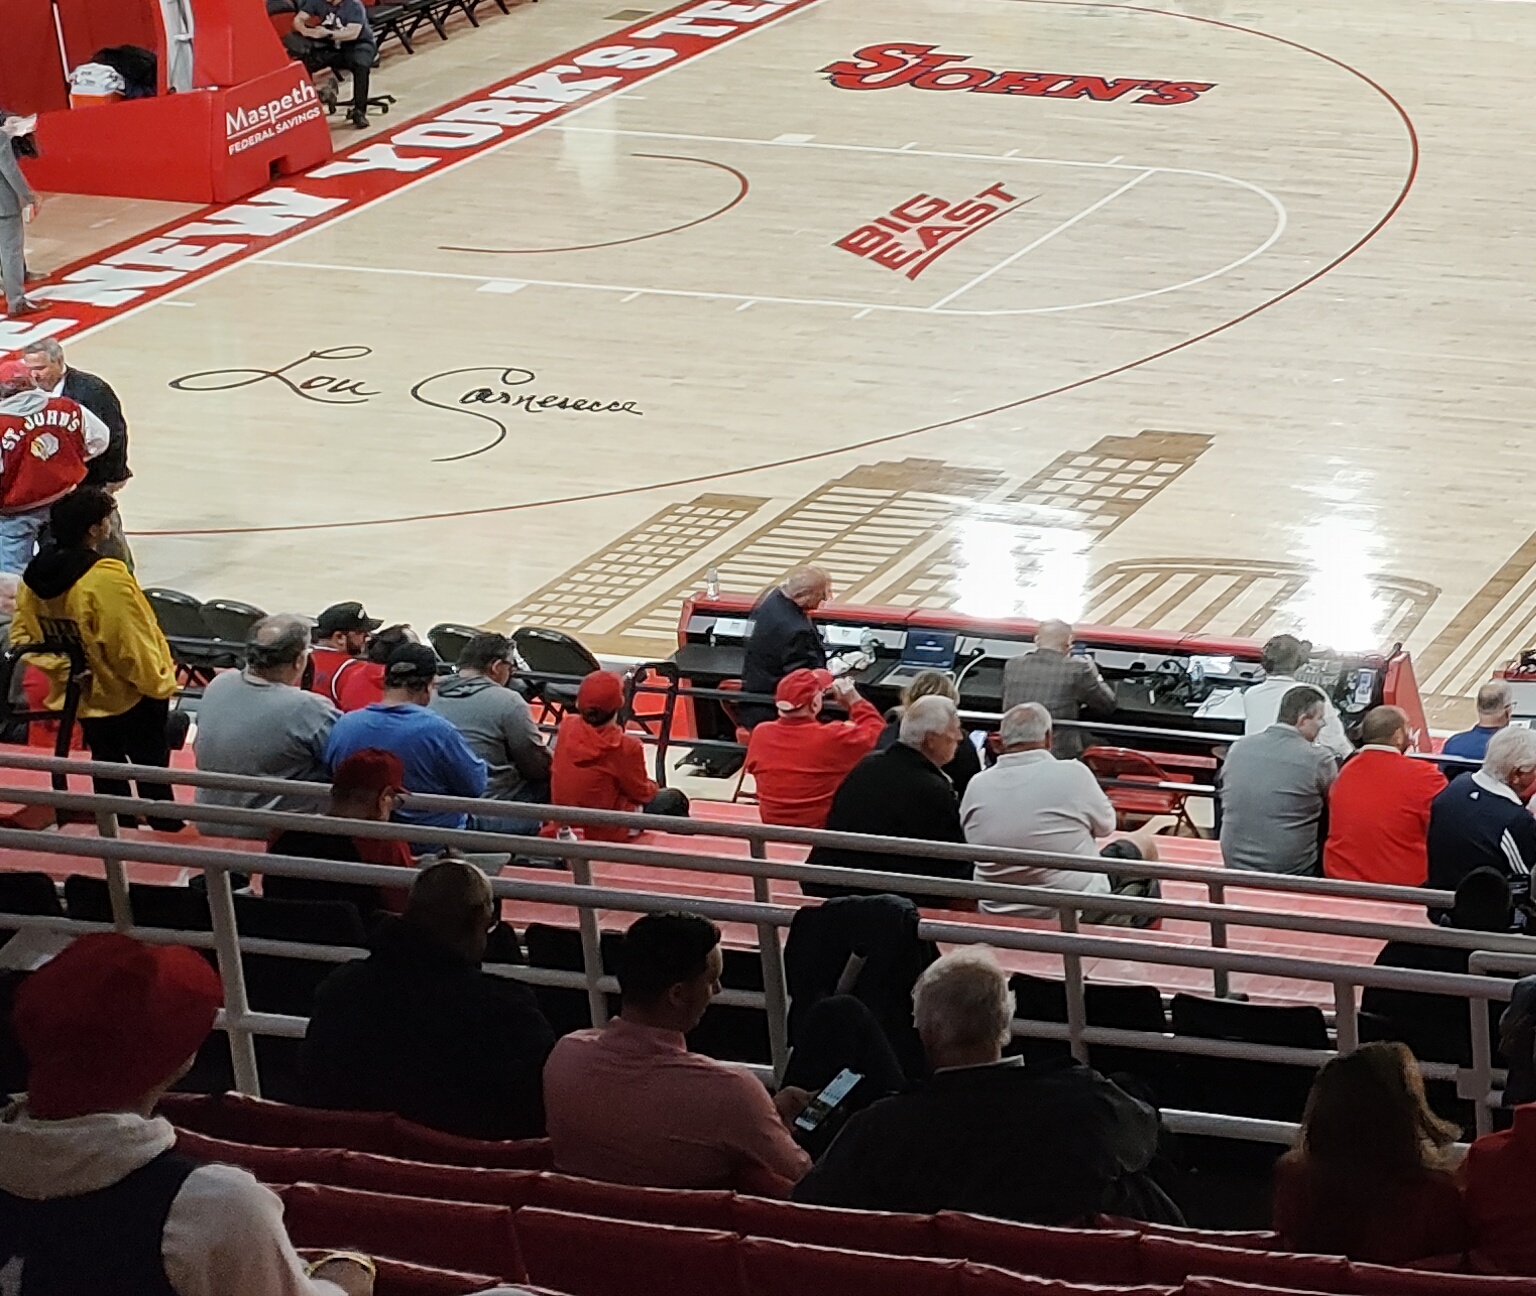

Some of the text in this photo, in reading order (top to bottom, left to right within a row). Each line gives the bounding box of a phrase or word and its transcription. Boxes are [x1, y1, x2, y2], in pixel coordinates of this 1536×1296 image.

[225, 80, 317, 140] Maspeth
[228, 106, 321, 156] FEDERAL SAVINGS
[27, 184, 349, 306] NEW
[308, 45, 678, 180] YORK'S
[833, 192, 952, 258] BIG
[869, 181, 1019, 272] EAST
[169, 344, 382, 405] Lou
[2, 409, 80, 451] ST. JOHN'S
